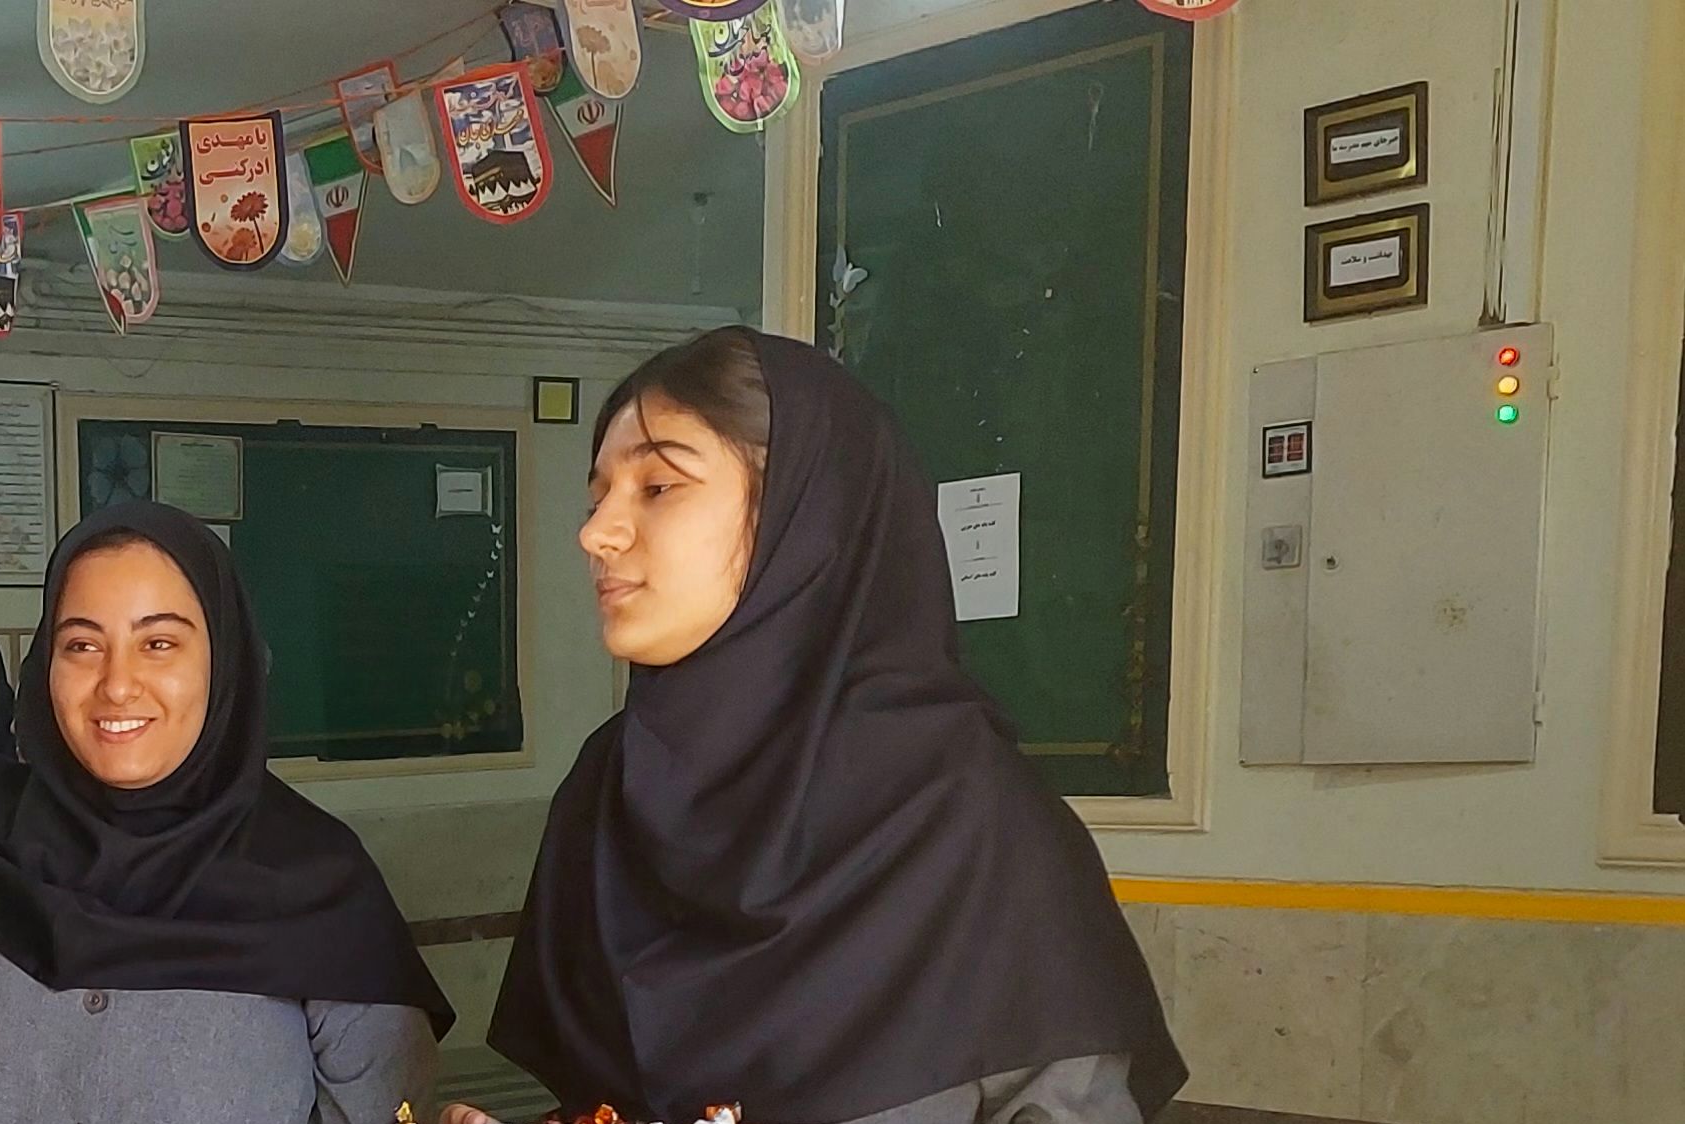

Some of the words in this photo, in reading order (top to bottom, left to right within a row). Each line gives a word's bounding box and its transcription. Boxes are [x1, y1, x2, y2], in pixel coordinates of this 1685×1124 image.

[196, 133, 254, 154] مهدی
[253, 127, 268, 150] یا
[199, 157, 270, 185] ادرکنی
